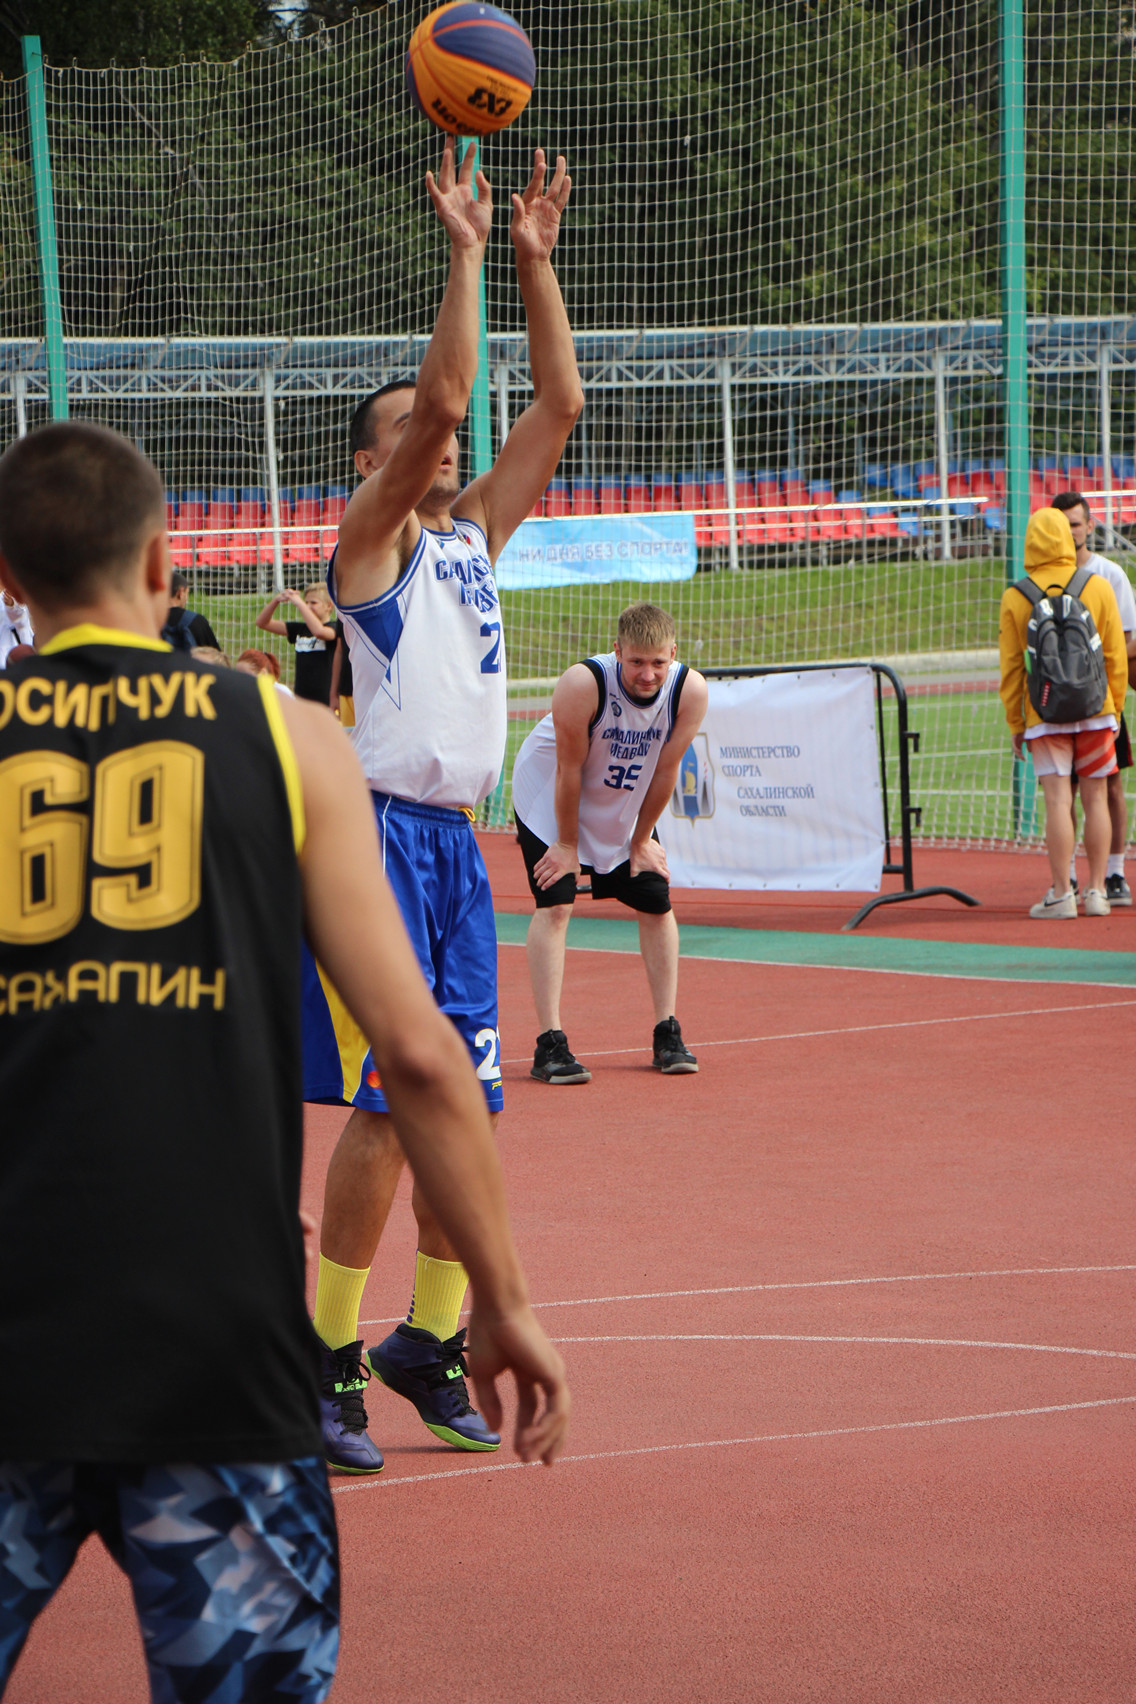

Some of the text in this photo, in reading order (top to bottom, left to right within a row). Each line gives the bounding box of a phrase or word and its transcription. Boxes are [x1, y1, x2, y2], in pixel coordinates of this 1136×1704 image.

[518, 547, 543, 562] НИ
[546, 544, 581, 562] ДНЯ
[584, 541, 613, 560] БЕЗ
[719, 745, 801, 759] МИНИСТЕРСТВО
[603, 764, 642, 791] 35
[721, 764, 762, 777] СПОРТА
[737, 784, 815, 799] САХАЛИНСКОЙ
[739, 805, 787, 817] ОБЛАСТИ
[0, 740, 204, 944] 69
